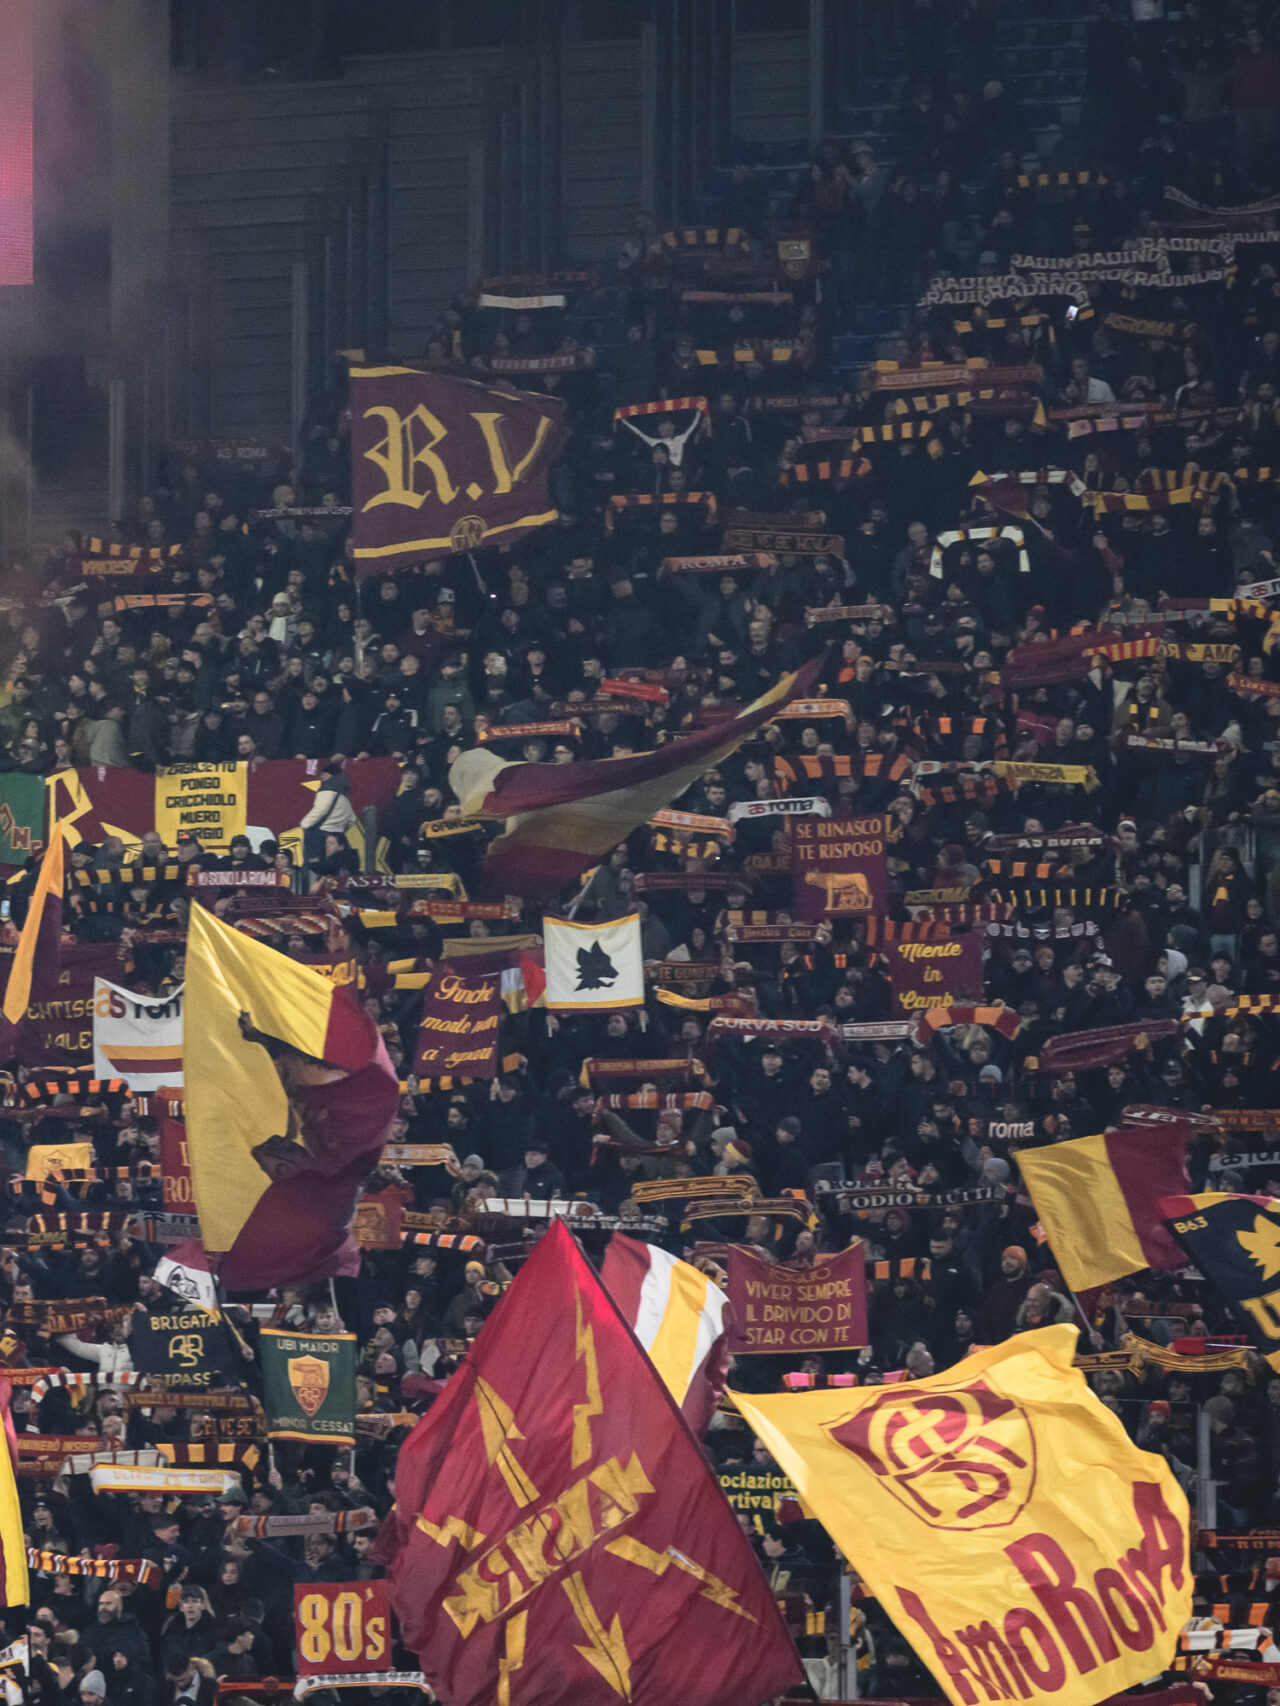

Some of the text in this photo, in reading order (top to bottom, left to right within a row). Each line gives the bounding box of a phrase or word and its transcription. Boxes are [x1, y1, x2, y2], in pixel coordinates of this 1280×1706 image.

[748, 798, 814, 816] as roma
[796, 818, 883, 839] SE RINASCO
[796, 839, 884, 861] TE RISPOSO
[898, 942, 963, 963] Niente
[923, 966, 944, 984] in
[95, 987, 128, 1019] as
[898, 991, 955, 1010] Camb
[781, 1017, 824, 1033] SUD
[988, 1121, 1036, 1139] roma
[852, 1193, 914, 1209] ODIO
[1173, 1215, 1209, 1235] B63
[745, 1278, 852, 1302] VIVER SEMPRE
[149, 1313, 221, 1331] BRIGATA
[746, 1302, 852, 1323] IL BRIVIDO DI
[746, 1326, 851, 1344] STAR CON TE
[276, 1338, 341, 1355] UBI MAIOR
[727, 1490, 774, 1511] rtiva
[299, 1586, 386, 1665] 80's
